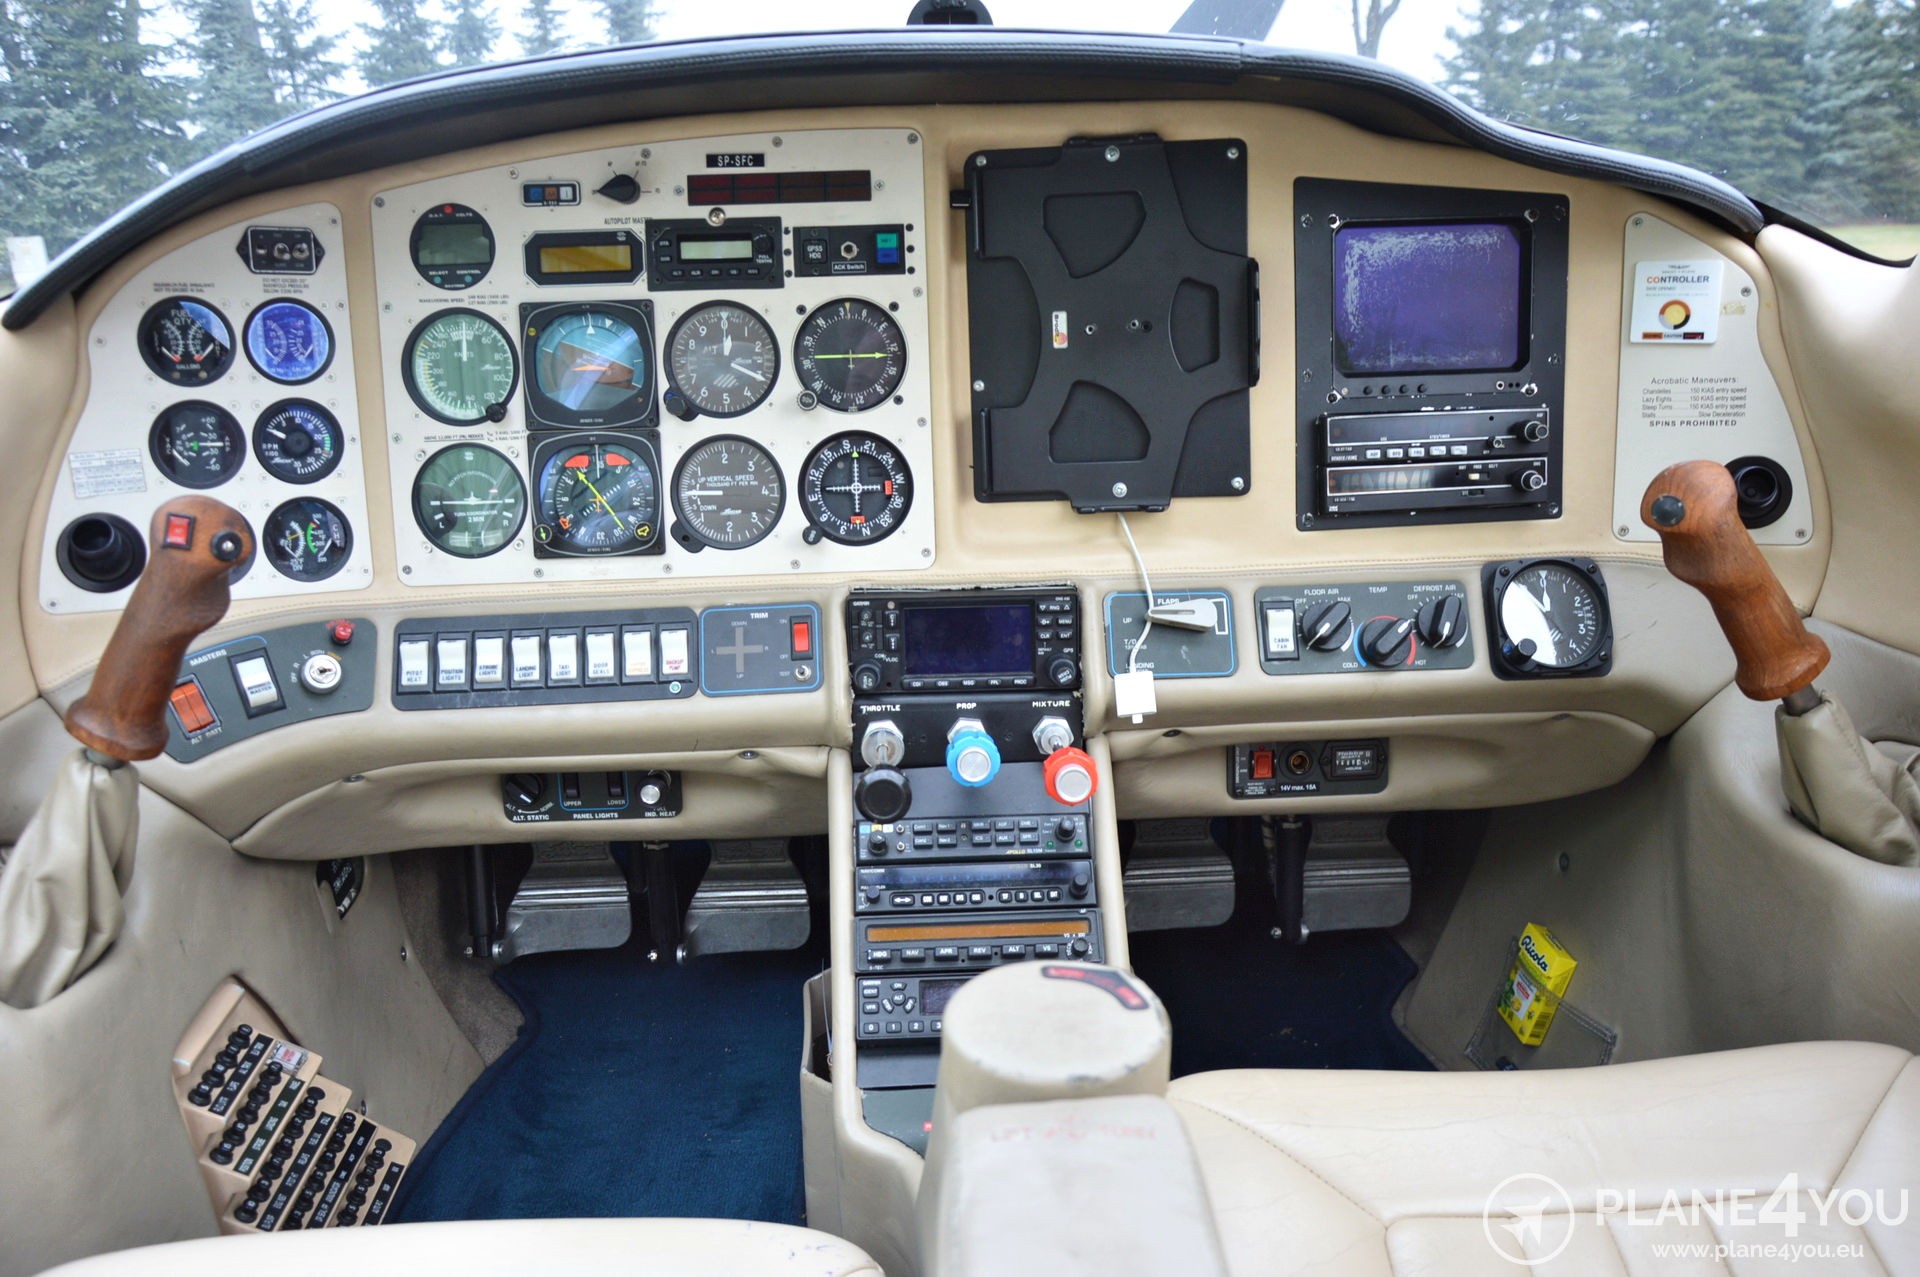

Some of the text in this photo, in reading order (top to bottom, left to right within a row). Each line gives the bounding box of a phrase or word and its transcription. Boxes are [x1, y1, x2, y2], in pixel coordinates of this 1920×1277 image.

[717, 155, 754, 167] SP-SFC
[846, 263, 864, 271] Switch
[1647, 276, 1710, 284] CONTROLLER
[173, 317, 192, 326] QTY
[699, 326, 707, 336] 9
[688, 339, 696, 350] 8
[755, 341, 762, 351] 2
[484, 392, 495, 400] 120
[700, 387, 708, 397] 6
[743, 386, 751, 396] 4
[723, 394, 730, 404] 5
[842, 440, 851, 449] S
[864, 441, 876, 451] 21
[722, 453, 728, 464] 2
[819, 450, 832, 460] 15
[883, 452, 895, 464] 24
[747, 461, 755, 472] 3
[734, 474, 755, 482] SPEED
[810, 469, 820, 481] 12
[761, 486, 769, 496] 4
[809, 493, 818, 502] E
[893, 495, 904, 508] 30
[751, 512, 758, 522] 3
[880, 514, 893, 528] 33
[726, 521, 734, 532] 2
[839, 525, 847, 535] 3
[1439, 584, 1456, 592] AIR
[1574, 596, 1581, 606] 2
[1578, 624, 1585, 634] 3
[190, 649, 227, 666] MASTERS
[860, 705, 900, 713] THROTTLE
[191, 736, 202, 745] ALT
[1521, 935, 1549, 972] Ricola
